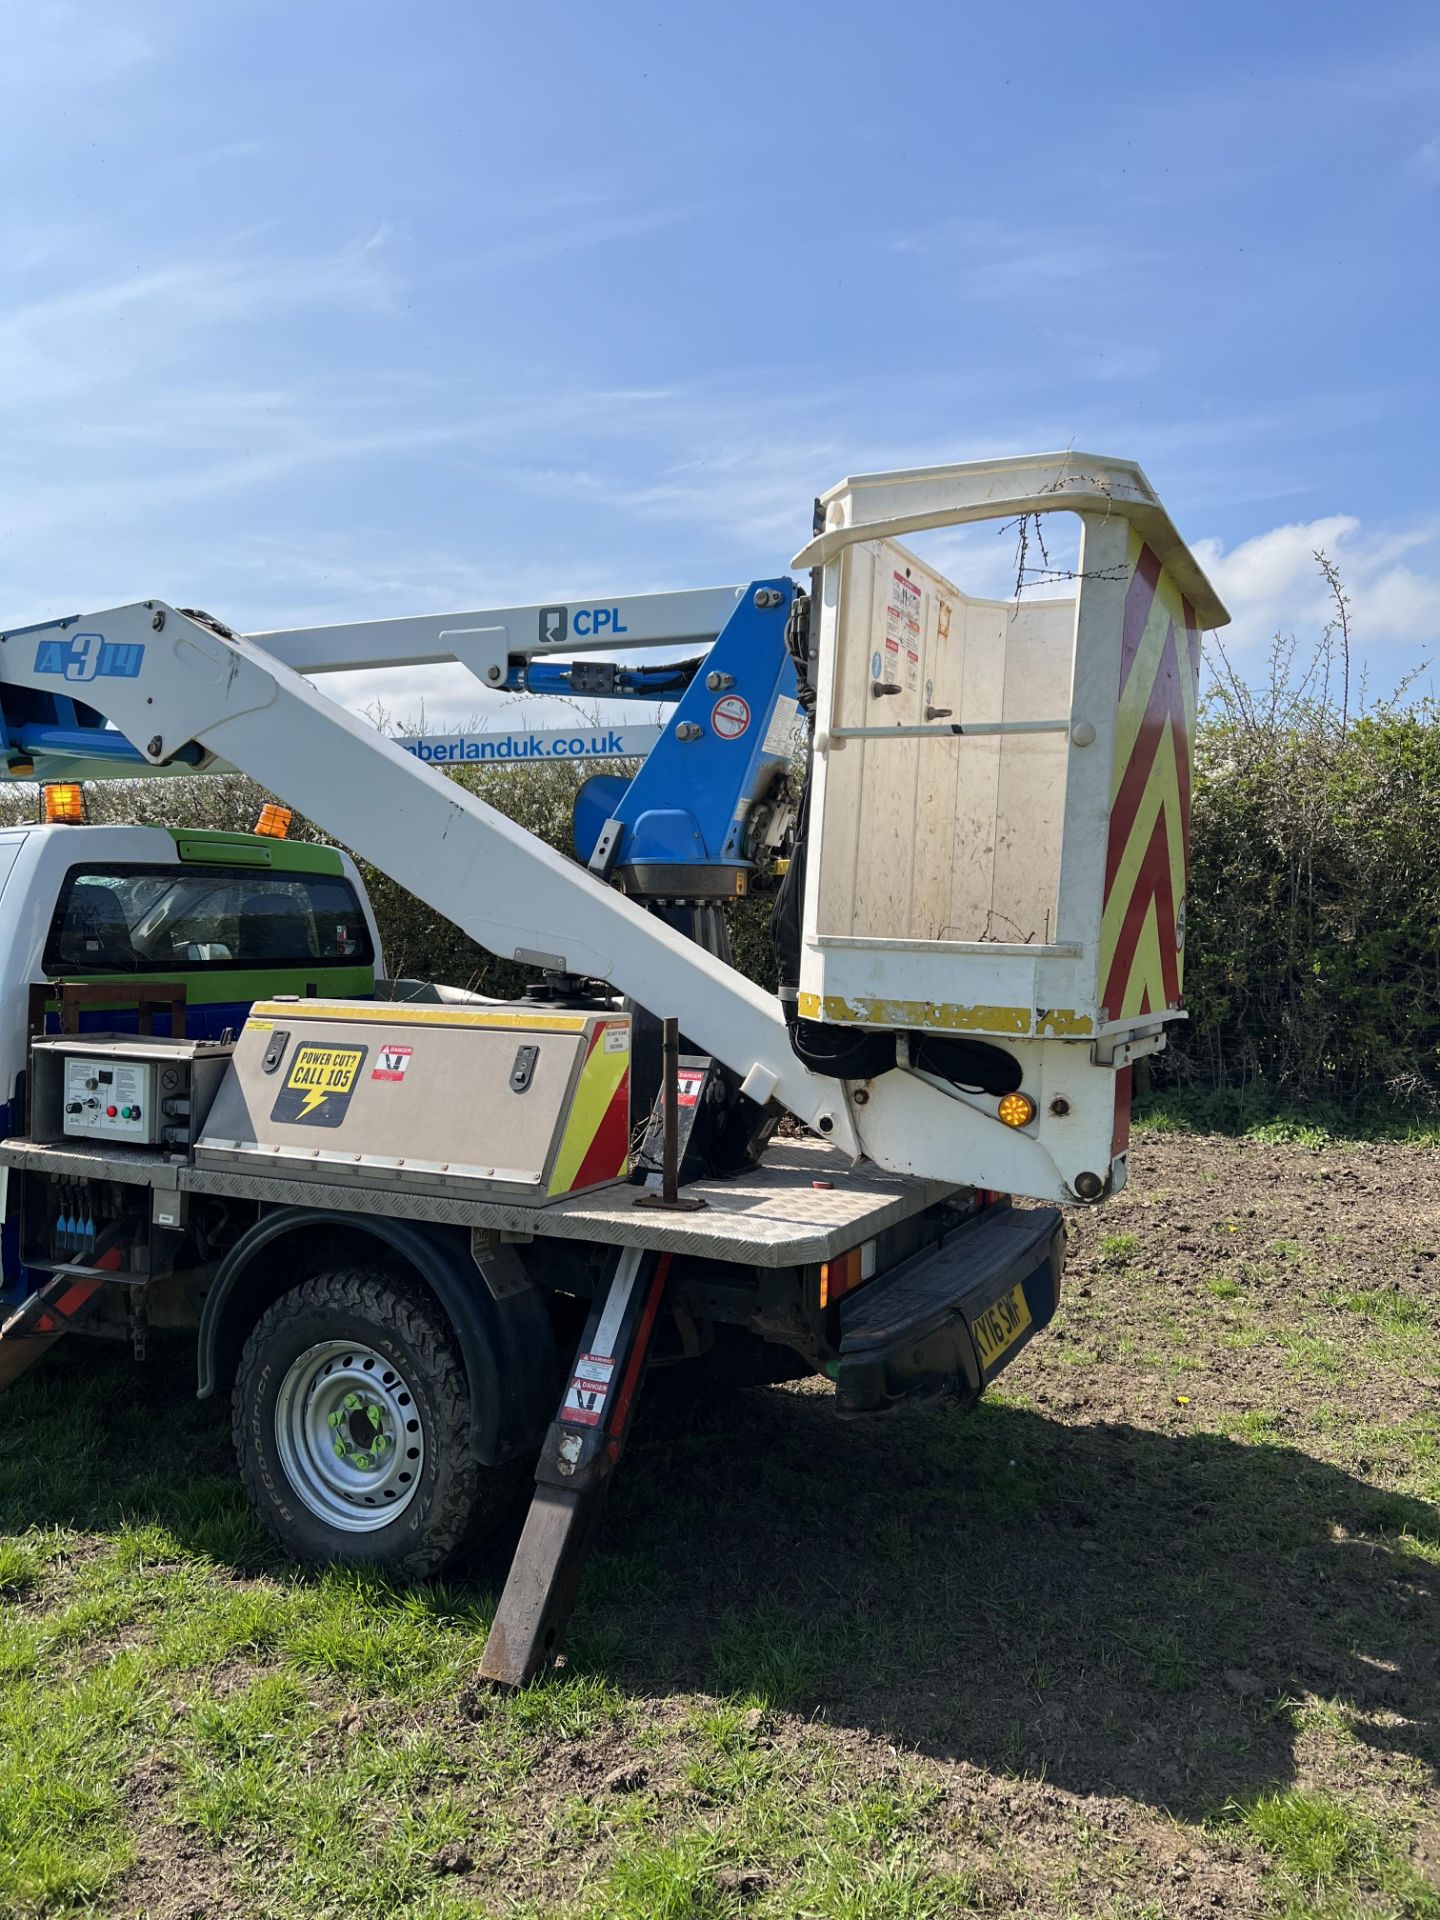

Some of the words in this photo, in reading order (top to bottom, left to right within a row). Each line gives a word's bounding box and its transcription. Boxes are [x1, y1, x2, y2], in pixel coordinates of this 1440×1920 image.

[573, 608, 628, 636] CPL
[390, 1046, 412, 1054] DANGER
[300, 1051, 332, 1066] POWER
[332, 1054, 357, 1068] CUT?
[293, 1066, 323, 1086] CALL
[326, 1069, 352, 1087] 105
[582, 1381, 608, 1391] DANGER
